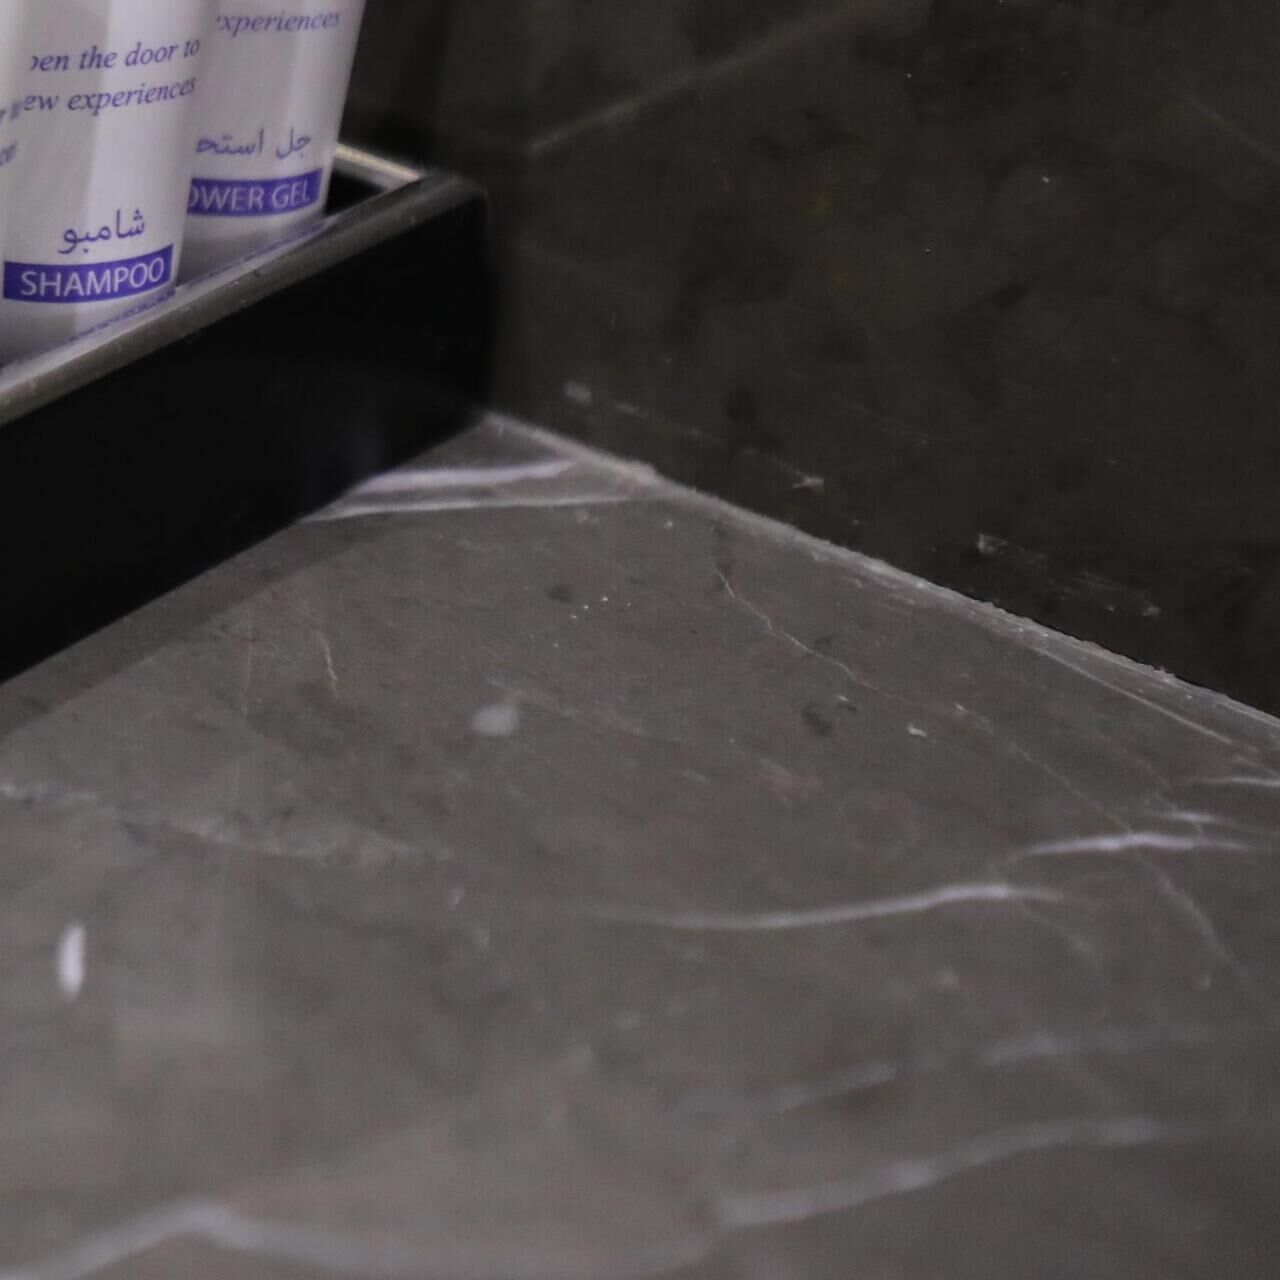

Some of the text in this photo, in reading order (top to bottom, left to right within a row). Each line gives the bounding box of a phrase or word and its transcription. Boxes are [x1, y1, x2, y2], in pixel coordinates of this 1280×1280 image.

[216, 10, 342, 38] xperiences
[79, 45, 118, 70] the
[124, 42, 180, 67] door
[183, 39, 200, 58] to
[67, 76, 197, 116] experiences
[272, 180, 310, 209] GEL
[57, 209, 145, 255] شامبو
[20, 256, 164, 297] SHAMPOO
